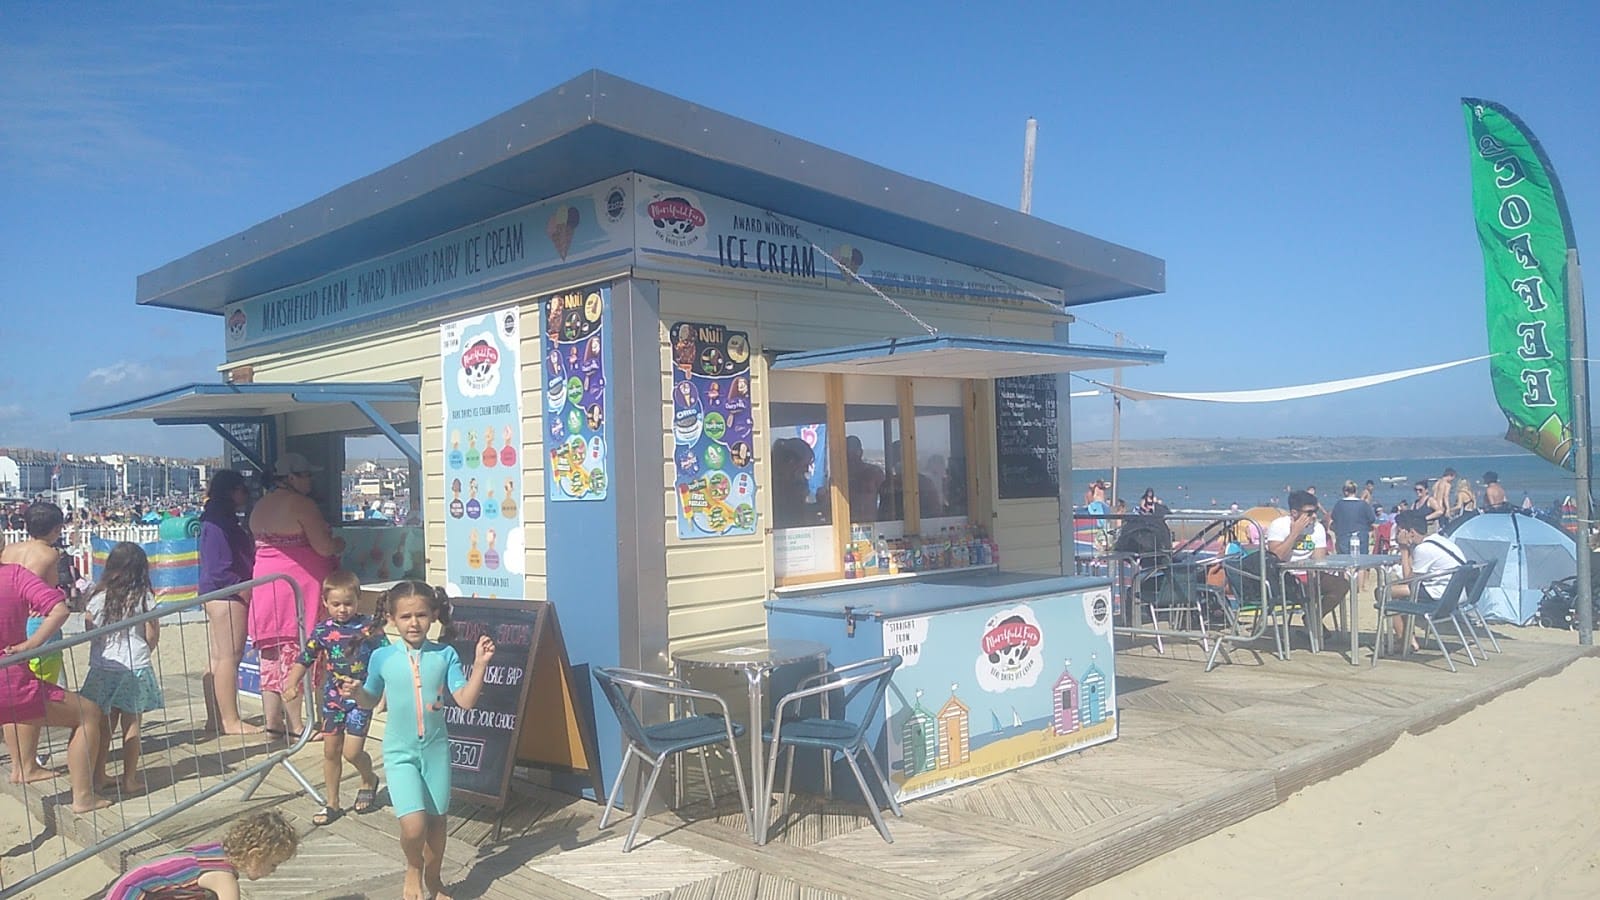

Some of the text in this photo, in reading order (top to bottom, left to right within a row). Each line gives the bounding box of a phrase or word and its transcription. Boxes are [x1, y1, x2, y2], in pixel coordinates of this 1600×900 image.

[733, 215, 801, 240] AWARD WINNING
[717, 233, 749, 270] ICE
[756, 239, 816, 279] CREAM
[262, 290, 319, 333] MARSHFIELD
[321, 277, 349, 317] FARM
[356, 267, 386, 307] AWARD
[390, 252, 430, 297] WINNING
[432, 242, 460, 286] DAIRY
[464, 236, 482, 277] ICE
[485, 221, 525, 270] CREAM
[901, 644, 919, 657] FARM
[506, 667, 523, 686] BAP
[467, 708, 477, 726] OF
